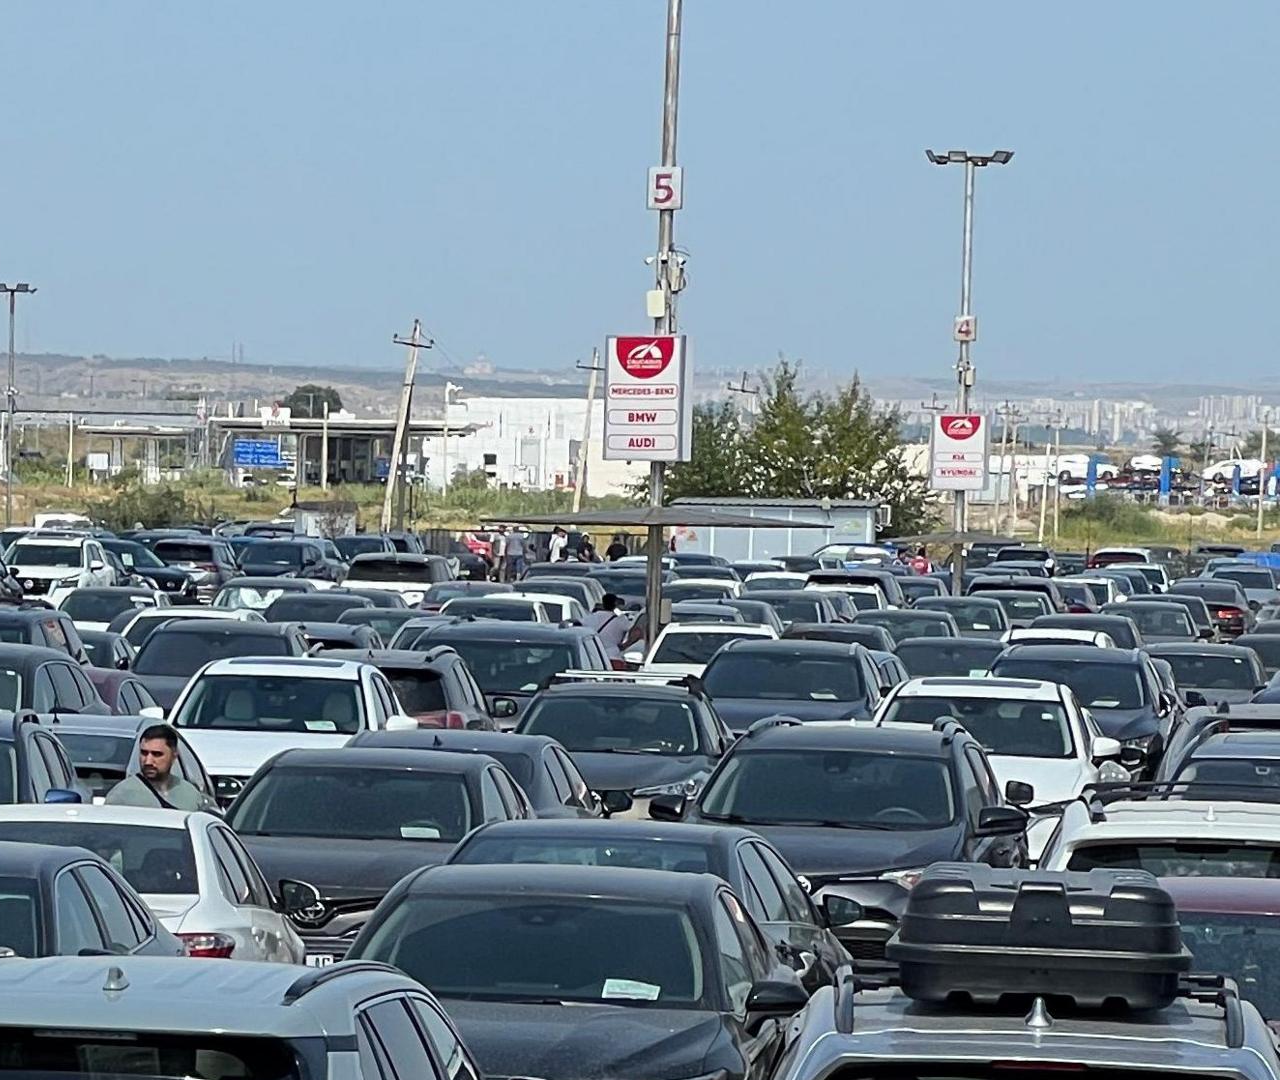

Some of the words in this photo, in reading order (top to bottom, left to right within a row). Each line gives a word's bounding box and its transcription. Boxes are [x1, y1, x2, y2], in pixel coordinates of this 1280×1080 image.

[653, 173, 675, 204] 5
[957, 319, 972, 338] 4
[628, 413, 657, 422] BMW
[628, 438, 655, 448] AUDI
